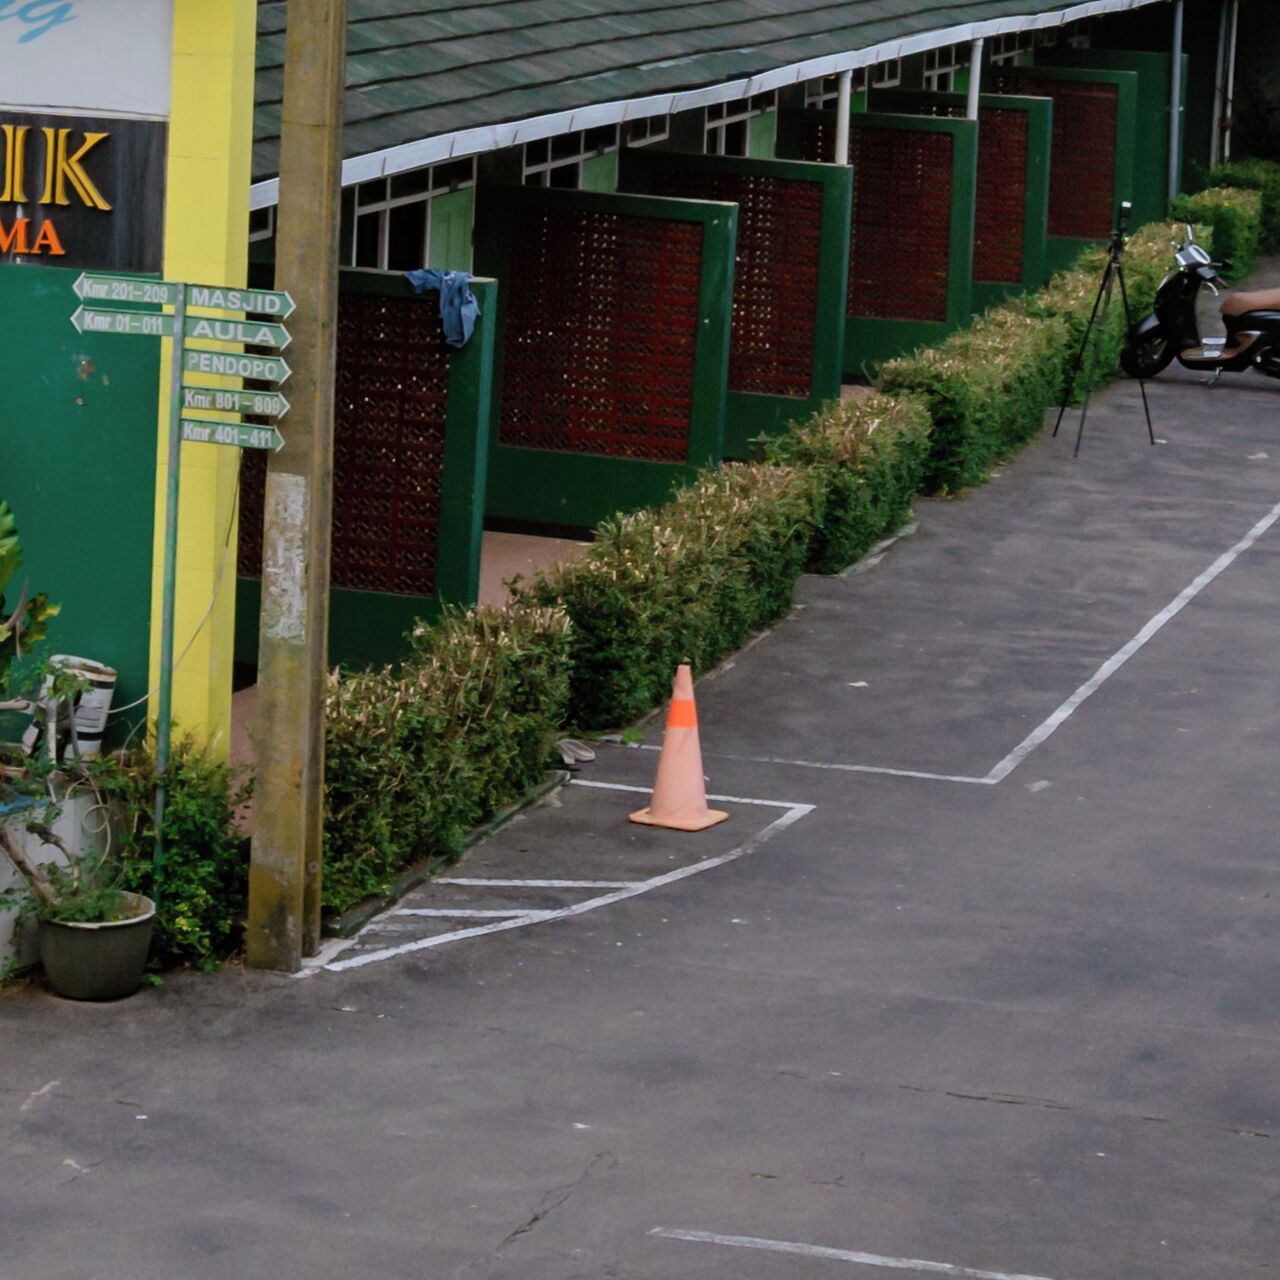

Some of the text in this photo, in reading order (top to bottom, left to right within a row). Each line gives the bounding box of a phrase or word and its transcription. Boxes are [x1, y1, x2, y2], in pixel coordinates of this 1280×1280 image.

[82, 278, 109, 297] Kmr
[191, 287, 281, 314] MASJID
[83, 311, 112, 330] Kmr
[192, 320, 276, 345] AULA
[188, 352, 278, 381] PENDOPO
[184, 388, 211, 408] Kmr
[182, 422, 210, 441] Kmr
